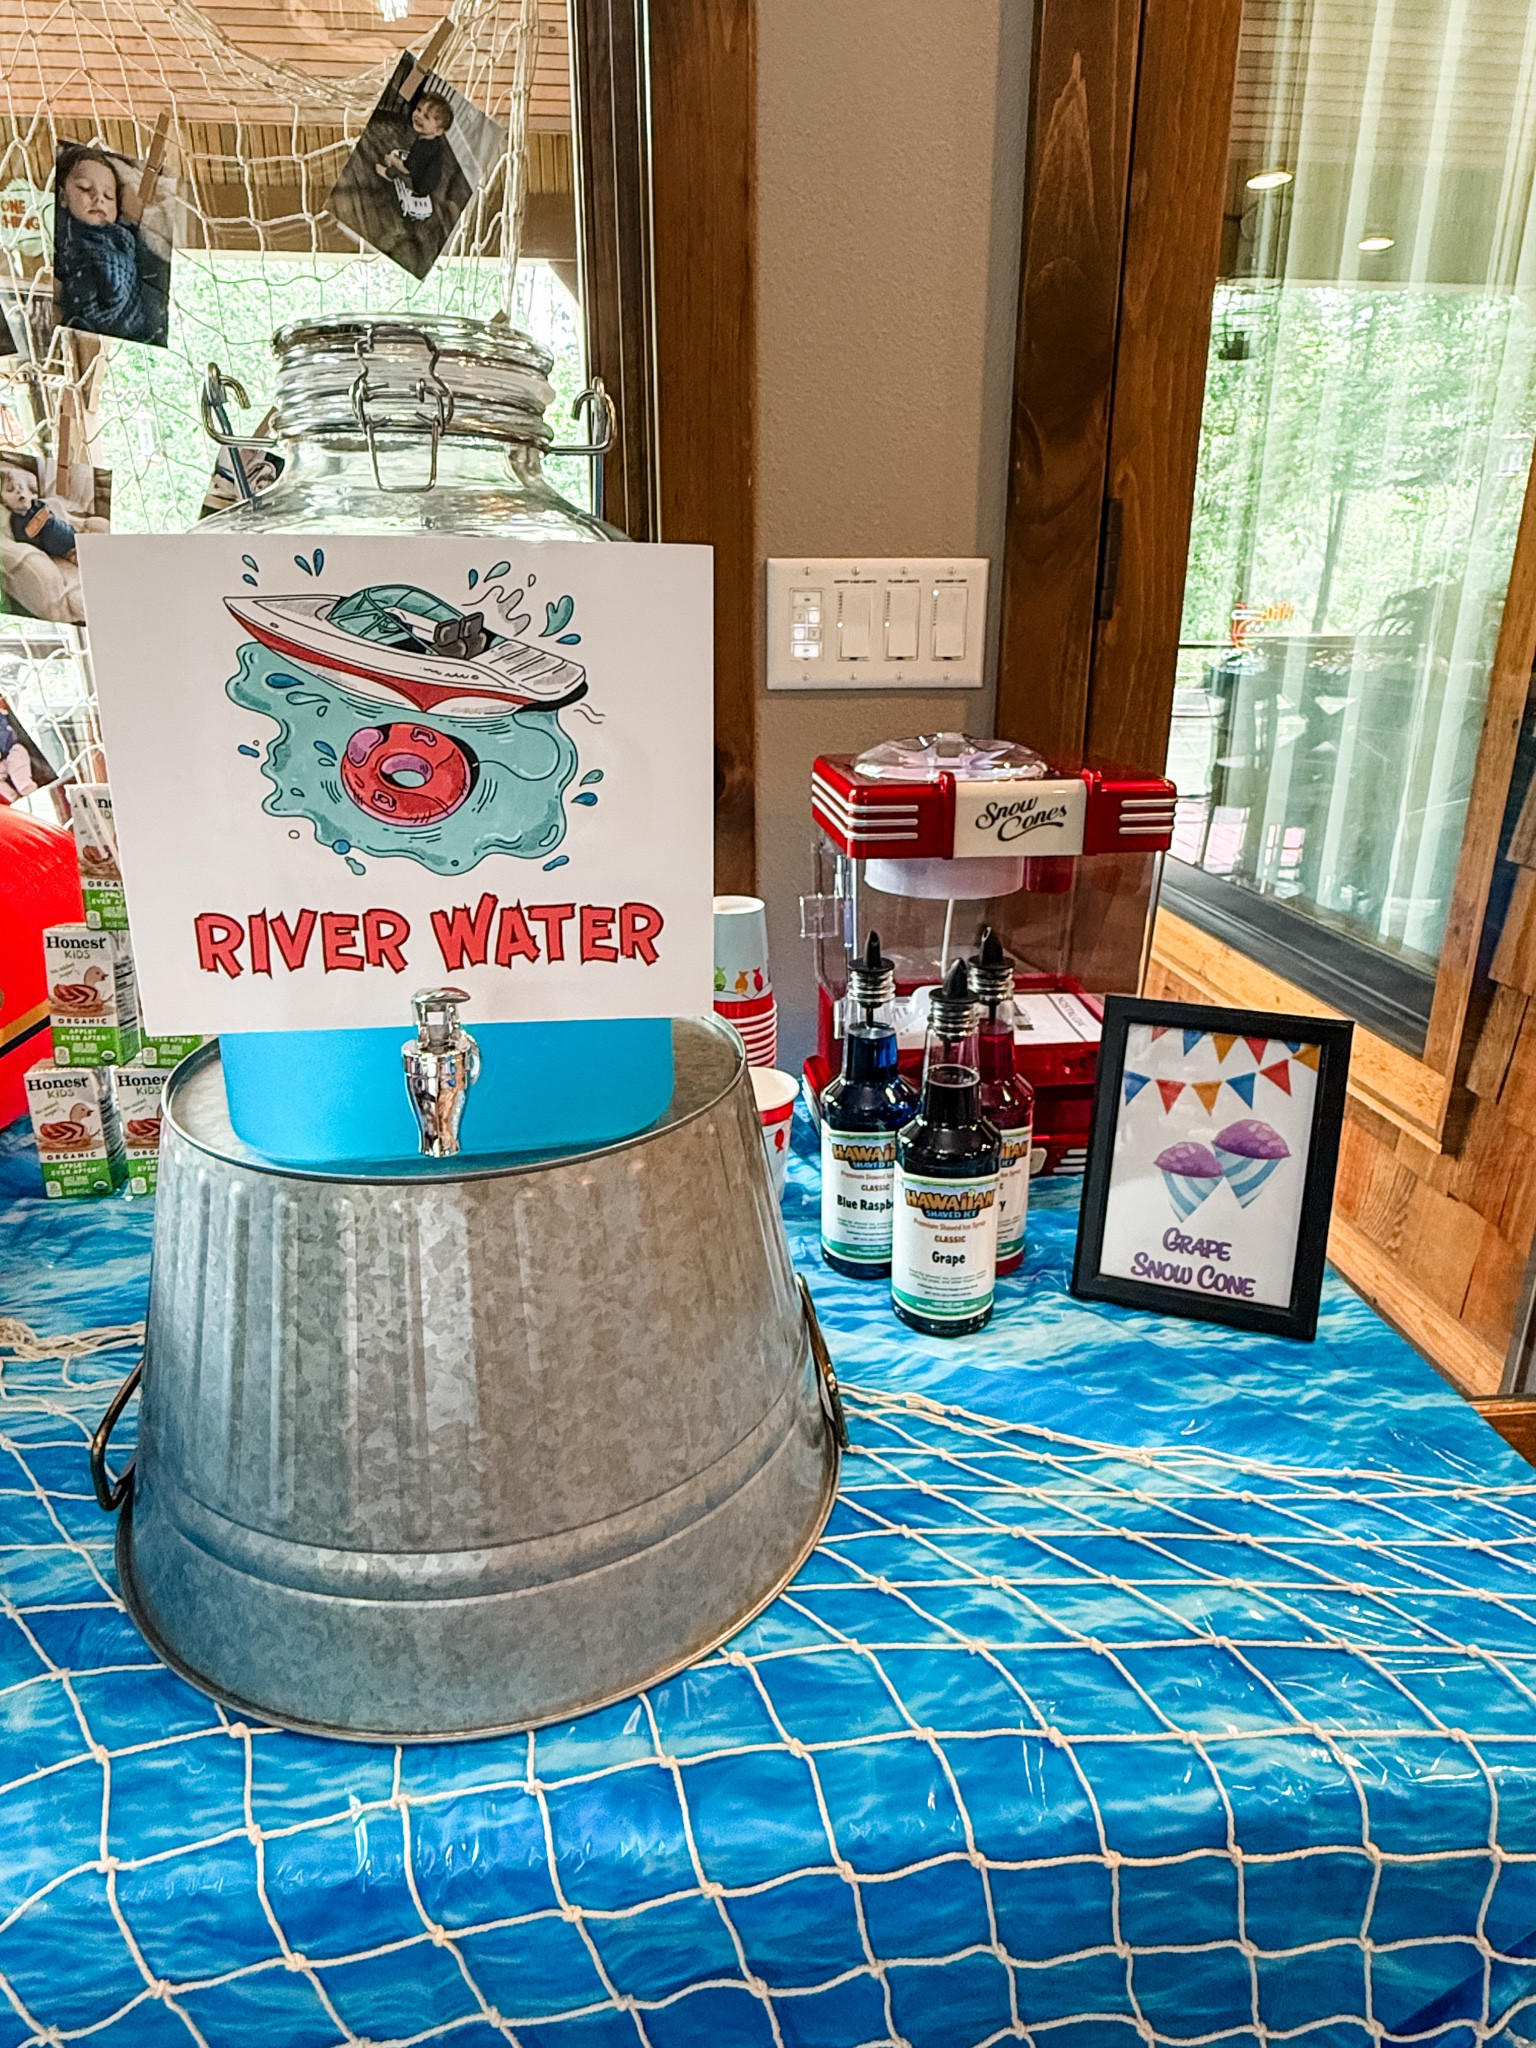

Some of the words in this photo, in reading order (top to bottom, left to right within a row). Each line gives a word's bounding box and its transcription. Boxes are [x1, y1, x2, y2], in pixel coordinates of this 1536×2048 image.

[975, 796, 1038, 830] Snow
[997, 804, 1067, 842] Cones
[45, 936, 107, 949] Honest
[194, 907, 411, 979] RIVER
[430, 892, 664, 973] WATER
[28, 1077, 88, 1091] Honest
[118, 1075, 168, 1087] Hones
[47, 1151, 96, 1160] ORGANIC
[861, 1184, 890, 1192] CLASSIC
[837, 1195, 858, 1210] Blue
[860, 1199, 893, 1213] Raspb
[925, 1210, 961, 1218] SHAVED
[934, 1235, 966, 1243] CLASSIC
[1163, 1227, 1232, 1262] GRAPE
[932, 1250, 966, 1267] Grape
[1130, 1251, 1193, 1286] SNOW
[1197, 1264, 1256, 1298] CONE
